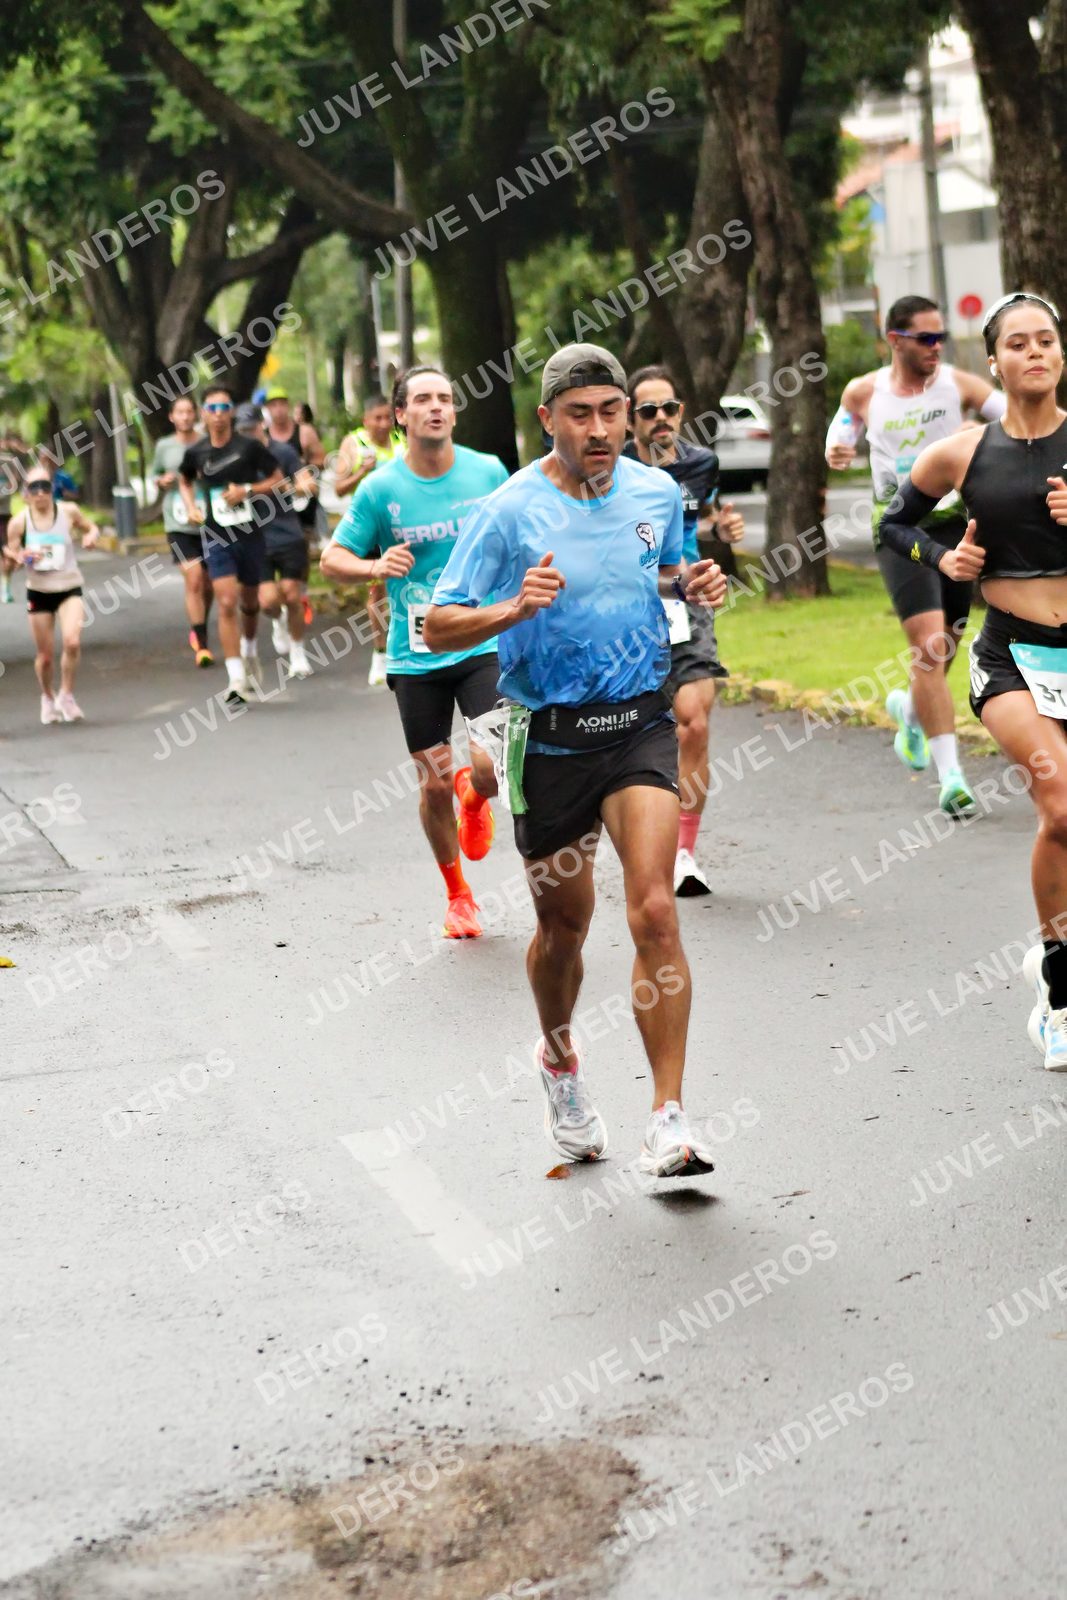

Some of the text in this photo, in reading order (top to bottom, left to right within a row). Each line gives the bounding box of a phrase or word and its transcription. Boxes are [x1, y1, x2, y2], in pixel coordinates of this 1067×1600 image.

[883, 417, 917, 431] RUN
[921, 409, 946, 424] UP!
[575, 709, 639, 728] AONIJIE
[584, 722, 632, 734] RUNNING
